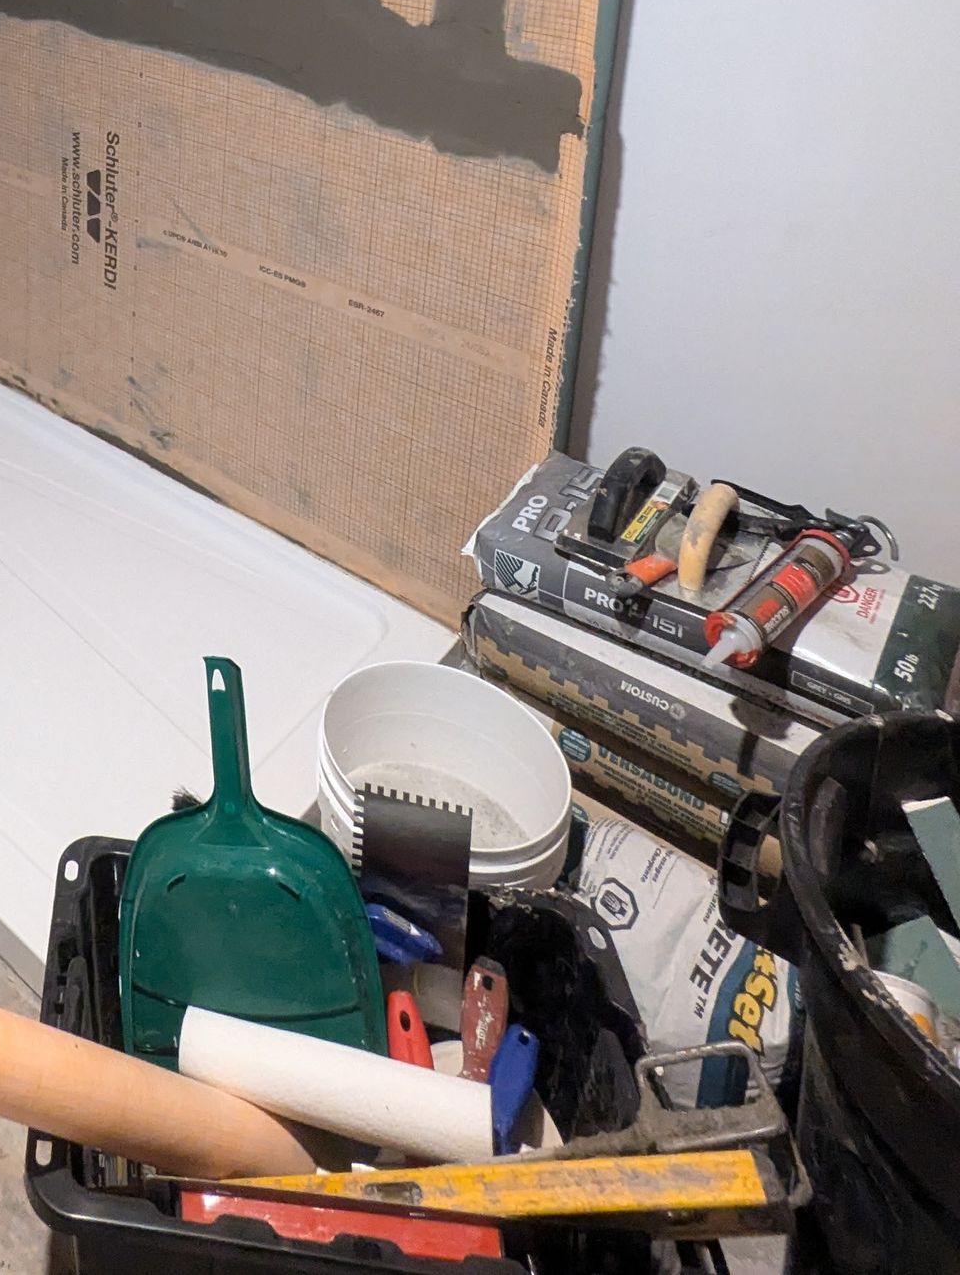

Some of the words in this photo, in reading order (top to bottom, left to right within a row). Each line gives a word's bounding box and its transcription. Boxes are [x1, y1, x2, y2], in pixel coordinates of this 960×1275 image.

[61, 156, 69, 181] Made
[61, 195, 69, 232] Canada
[71, 131, 81, 265] www.schluter.com
[545, 327, 558, 364] Made
[543, 363, 553, 379] in
[538, 379, 552, 429] Canada
[511, 494, 549, 534] PRO
[583, 587, 624, 614] PRO
[855, 586, 879, 620] DANGER
[893, 659, 915, 684] 50
[620, 679, 670, 711] CUSTOM
